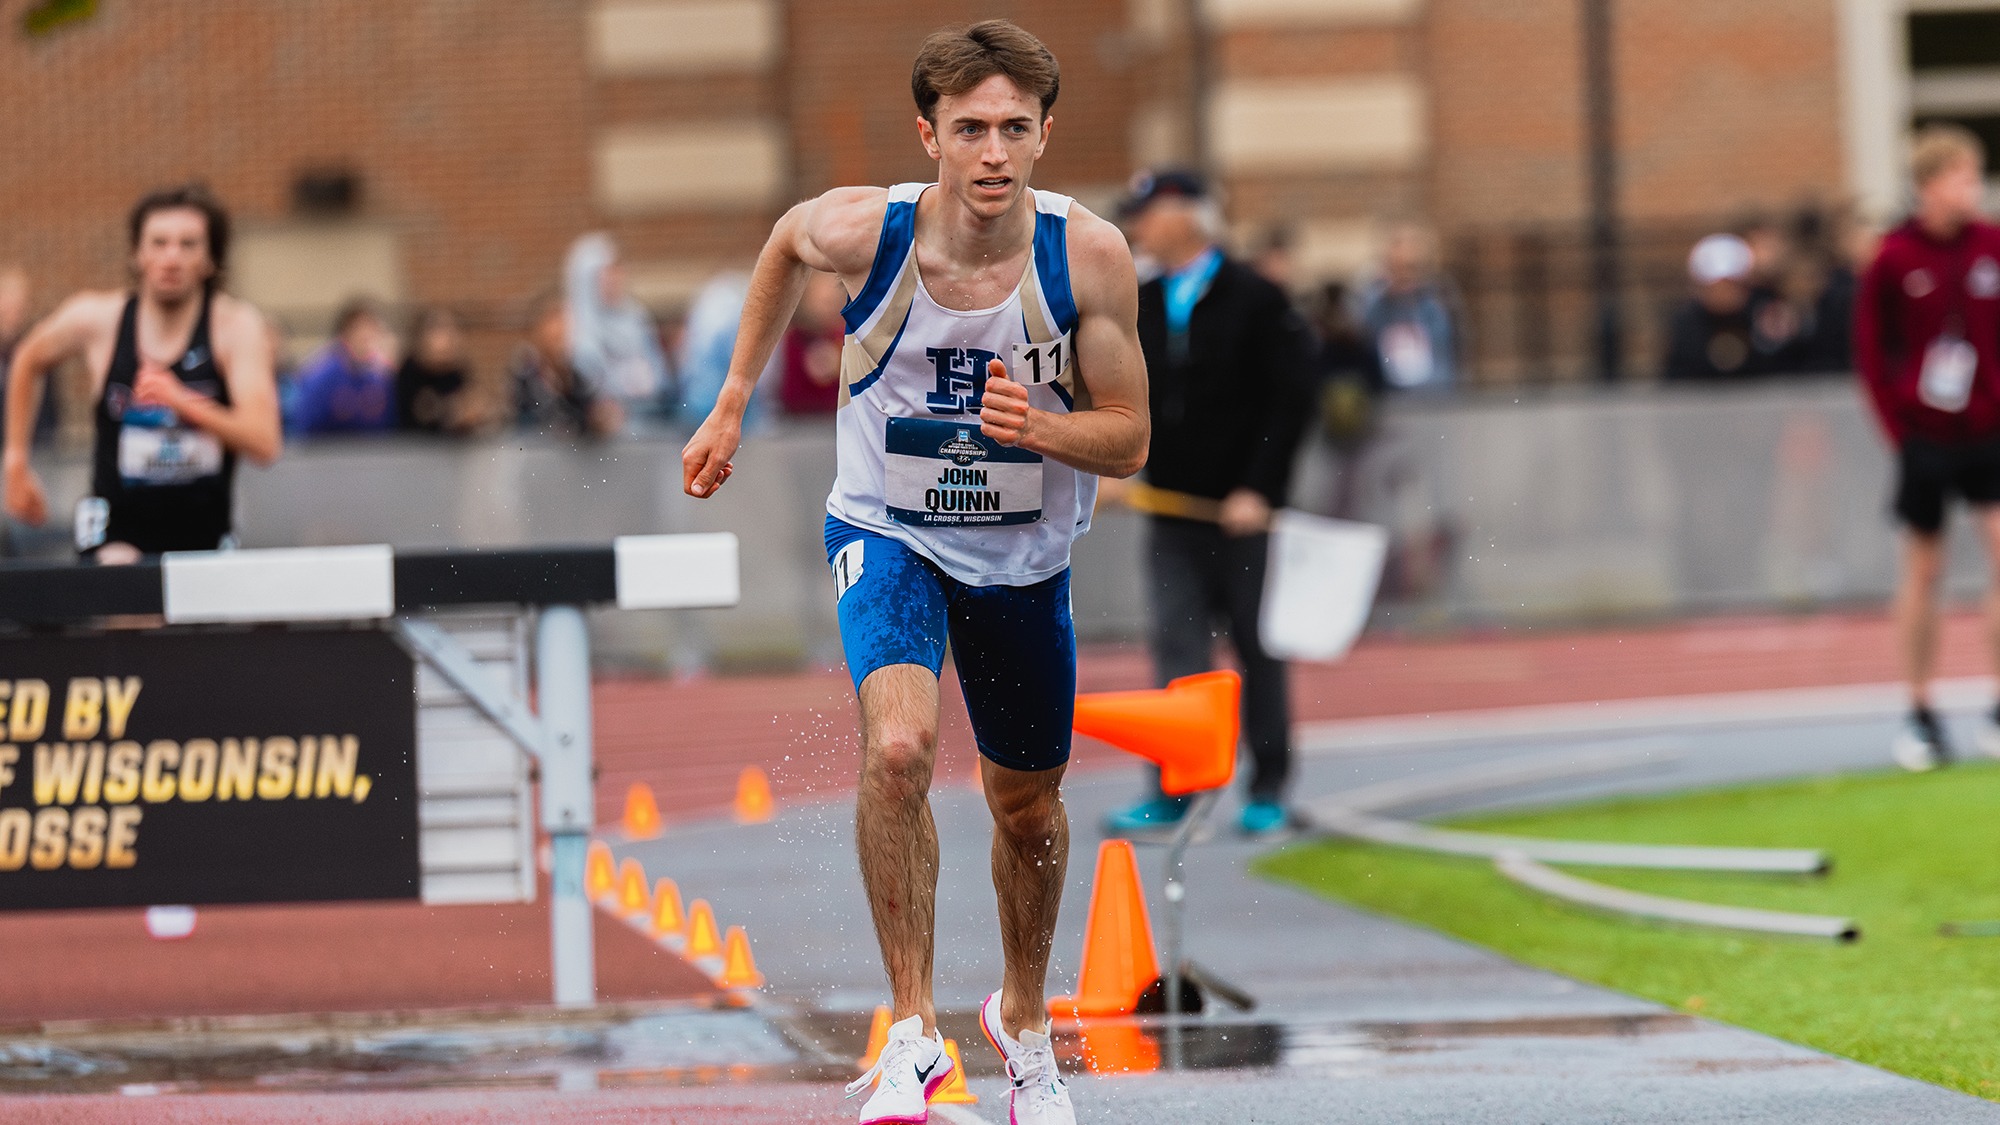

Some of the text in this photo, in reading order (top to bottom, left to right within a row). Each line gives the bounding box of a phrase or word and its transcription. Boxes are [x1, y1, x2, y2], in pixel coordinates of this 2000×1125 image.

[1023, 342, 1062, 383] 11
[940, 447, 987, 457] CHAMPIONSHIPS
[938, 468, 988, 486] JOHN
[925, 489, 1001, 513] QUINN
[924, 514, 1003, 523] LA CROSSE, WISCONSIN
[63, 676, 143, 741] BY
[33, 735, 372, 805] WISCONSIN,
[0, 806, 143, 872] OSSE
